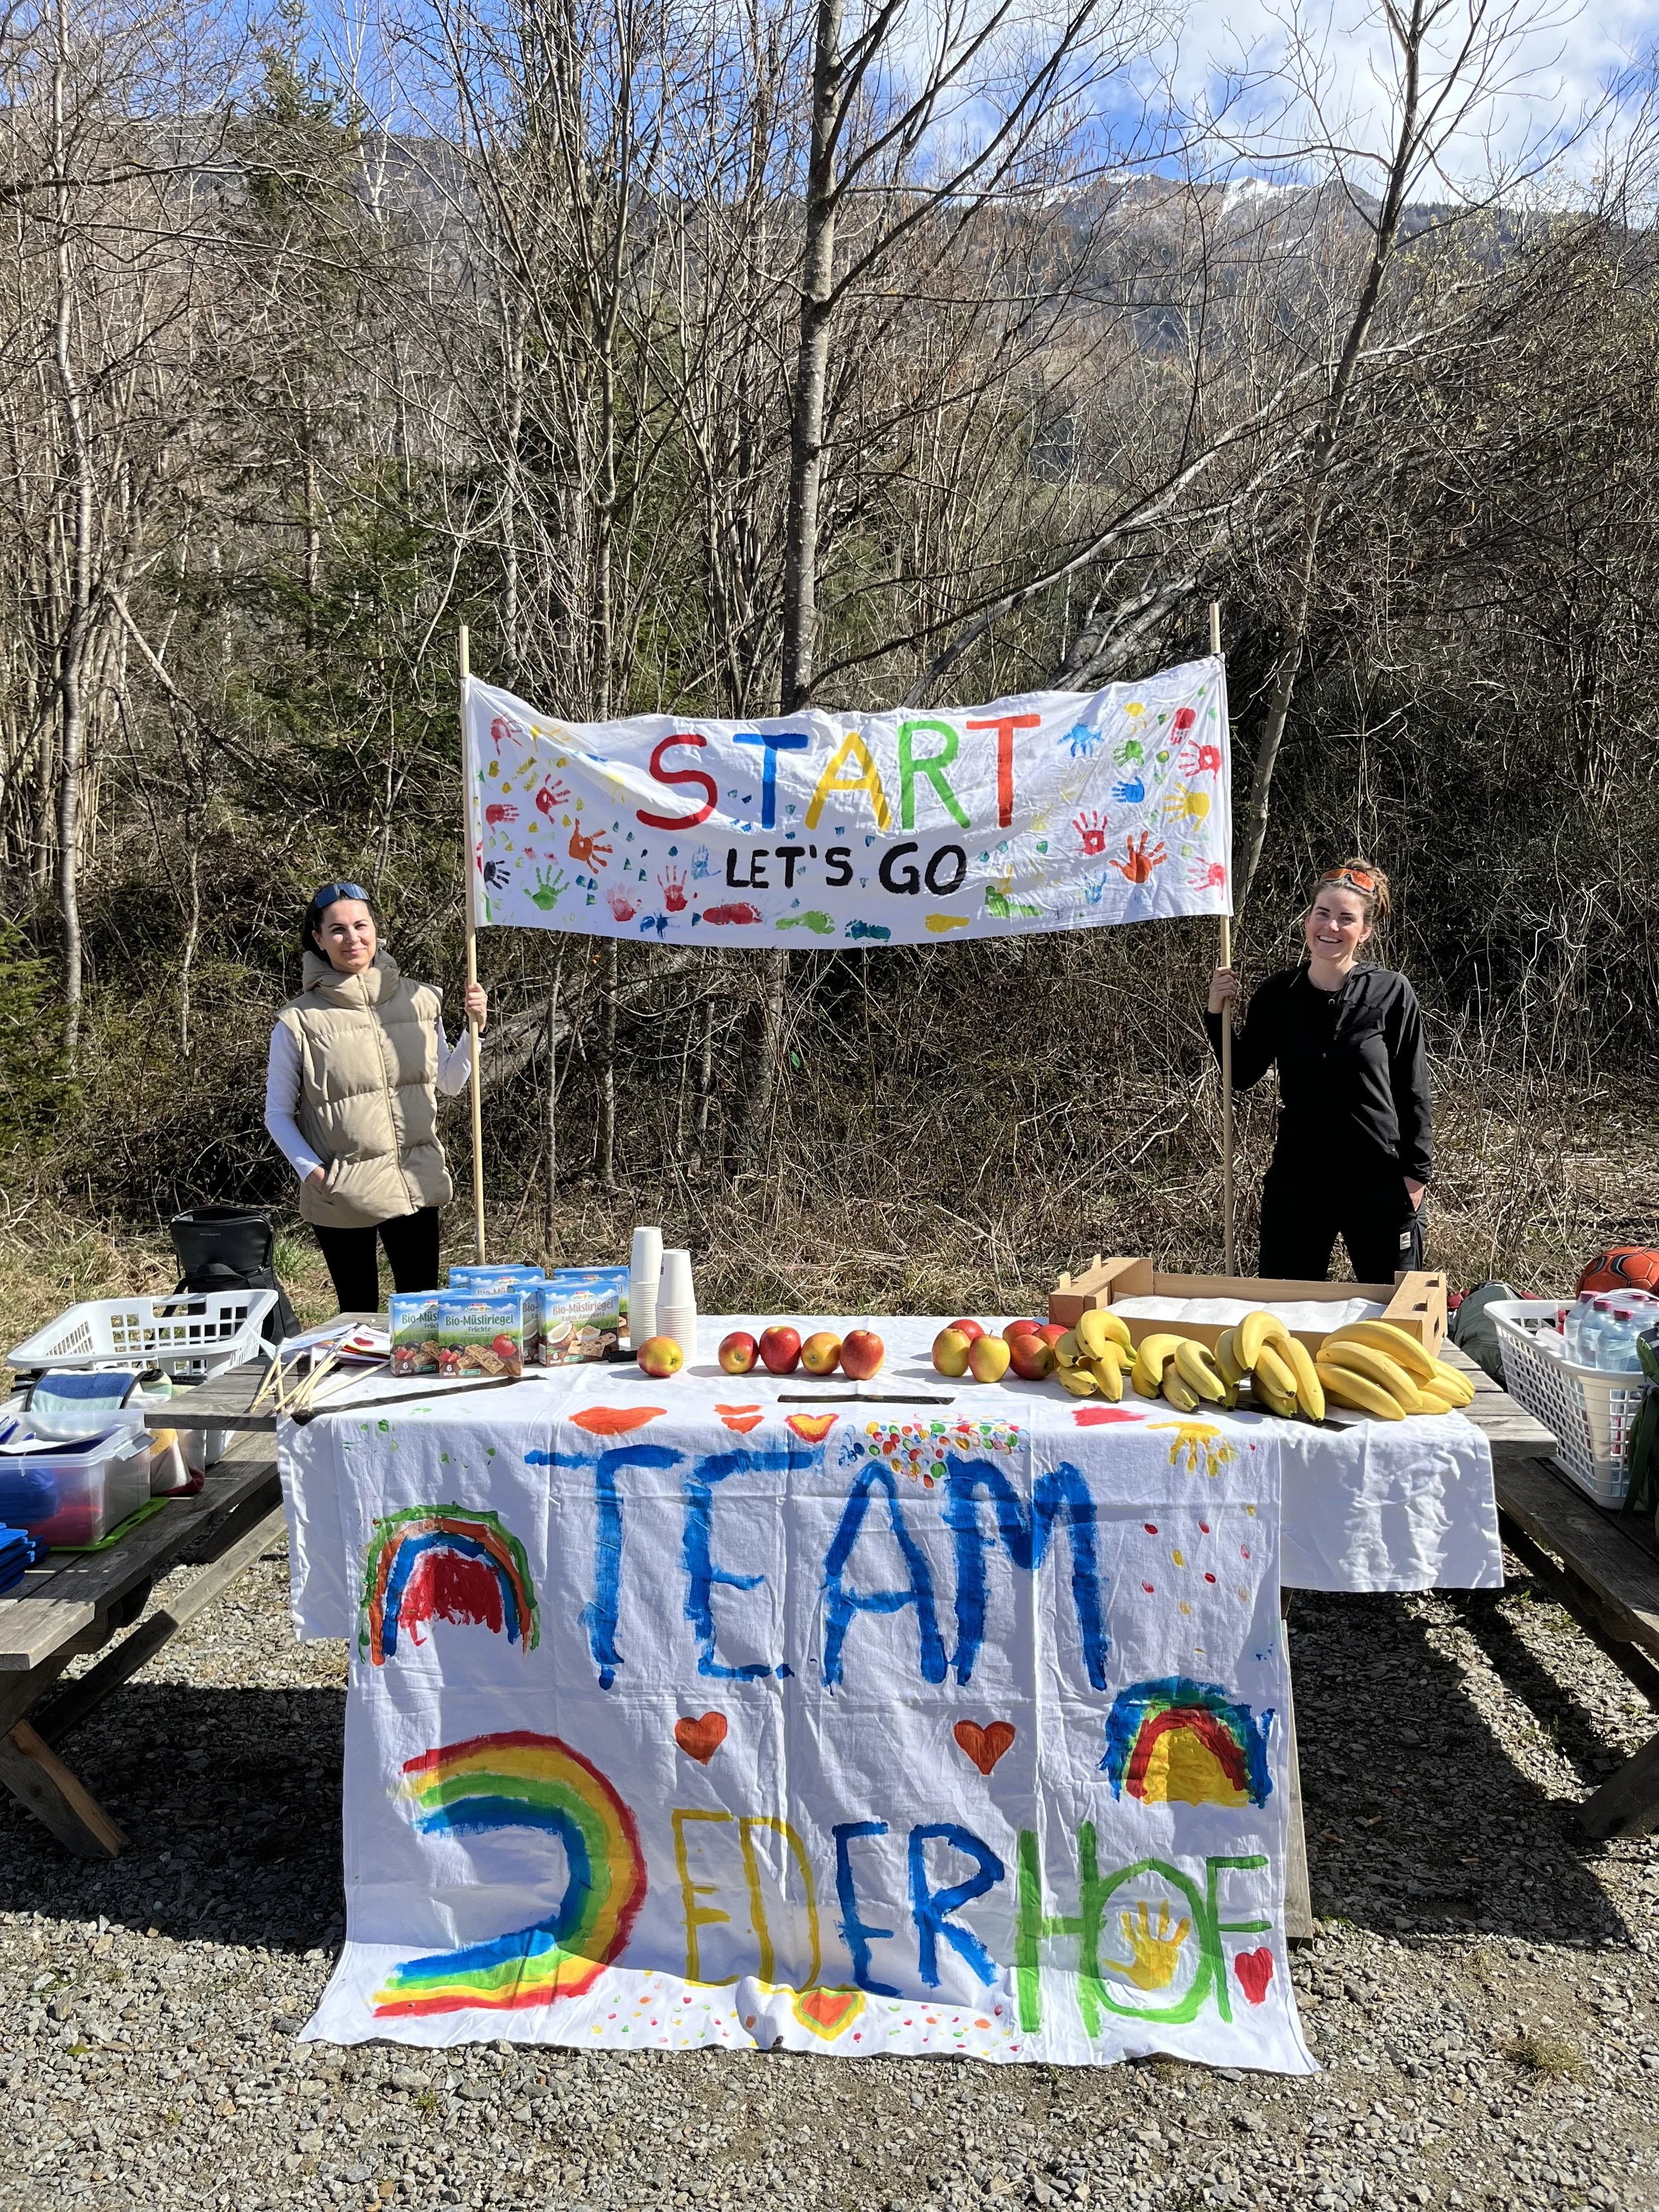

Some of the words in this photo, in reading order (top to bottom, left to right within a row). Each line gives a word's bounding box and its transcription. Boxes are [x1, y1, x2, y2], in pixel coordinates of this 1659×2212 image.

[636, 713, 1041, 832] START
[726, 846, 854, 890] LET'S
[878, 841, 968, 895] GO
[445, 1314, 514, 1326] Bio-Müsliriegel
[553, 1299, 614, 1315] Bio-Müsliriegel
[524, 1443, 1108, 1690] TEAM
